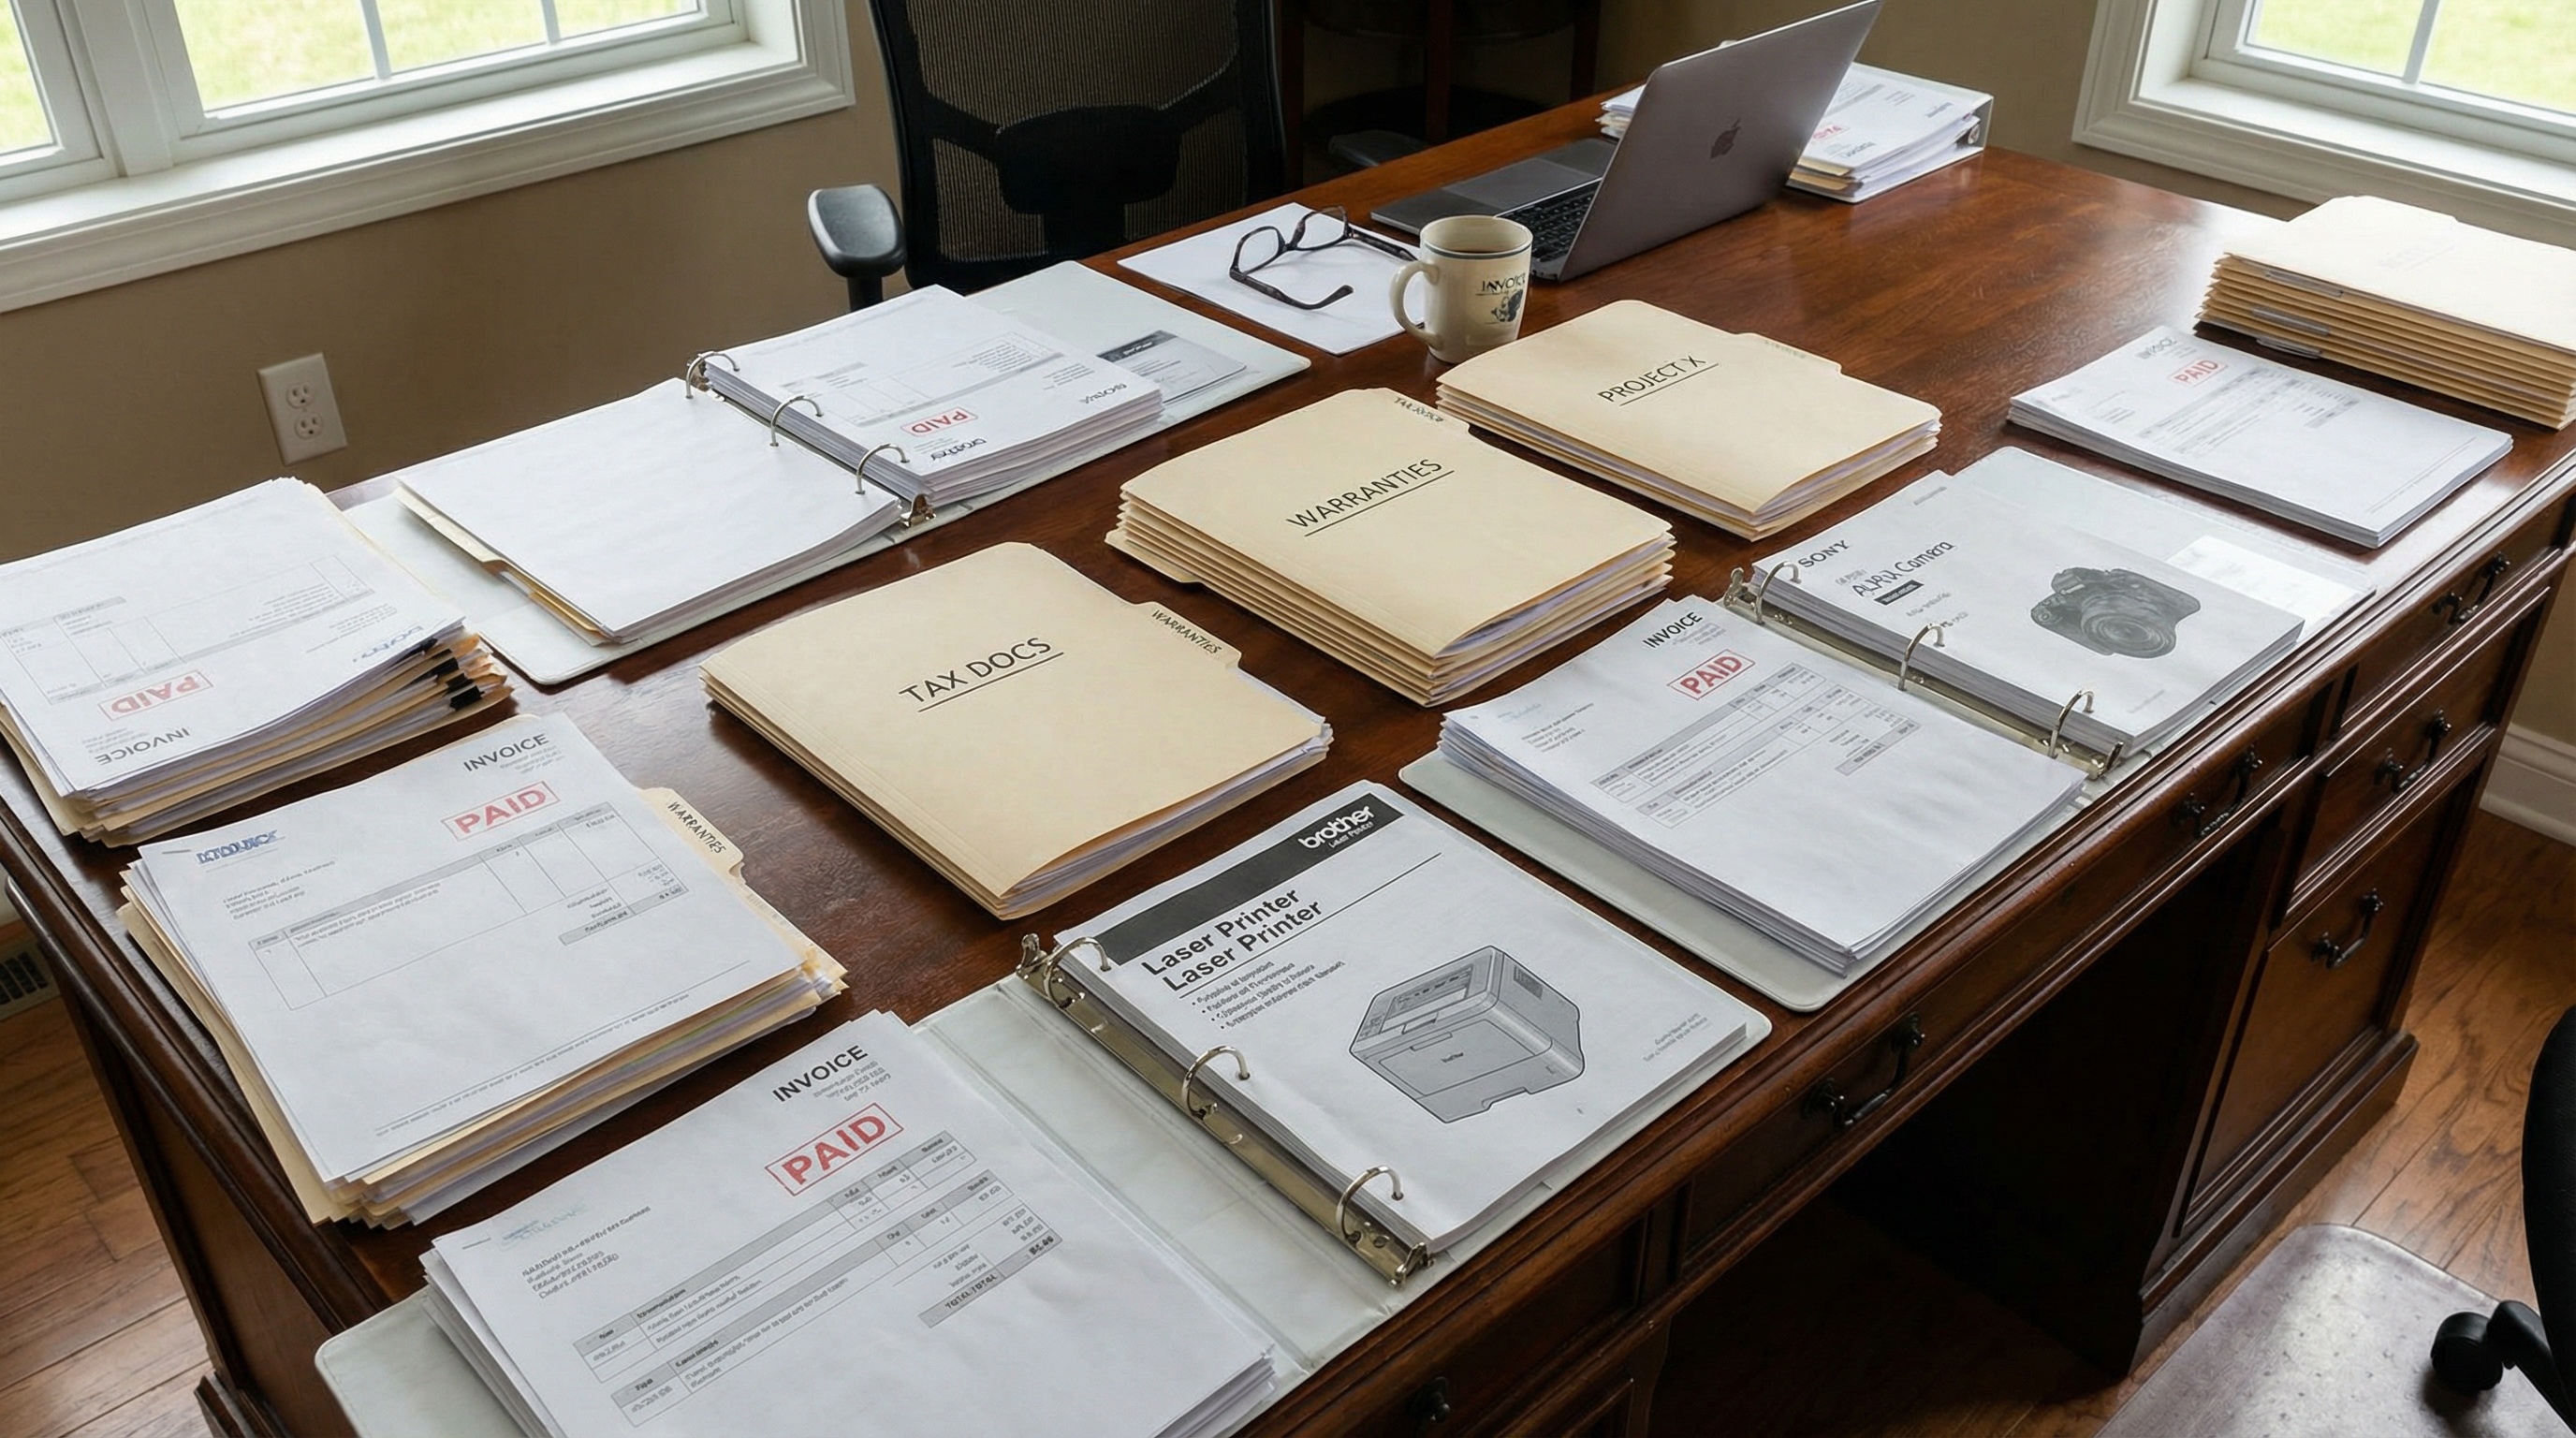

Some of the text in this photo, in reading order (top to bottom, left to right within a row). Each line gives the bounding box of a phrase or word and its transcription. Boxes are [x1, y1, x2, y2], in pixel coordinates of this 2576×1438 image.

[1598, 355, 1705, 402] PROJECT X
[2174, 360, 2218, 383] PAID
[912, 411, 968, 433] PAID
[1286, 459, 1442, 527] WARRANTIES
[1798, 539, 1850, 568] SONY
[1152, 609, 1222, 654] WARRANTIES
[1643, 611, 1703, 648] INVOICE
[899, 638, 1051, 702] TAX DOCS
[1680, 656, 1742, 694] PAID
[111, 676, 199, 713] PAID
[95, 727, 190, 766] INVOICE
[463, 733, 549, 771] INVOICE
[454, 789, 546, 834] PAID
[1297, 806, 1374, 848] brother
[1141, 889, 1299, 976] Laser Printer
[1163, 902, 1322, 990] Laser Printer
[772, 1045, 868, 1102] INVOICE
[782, 1115, 886, 1185] PAID
